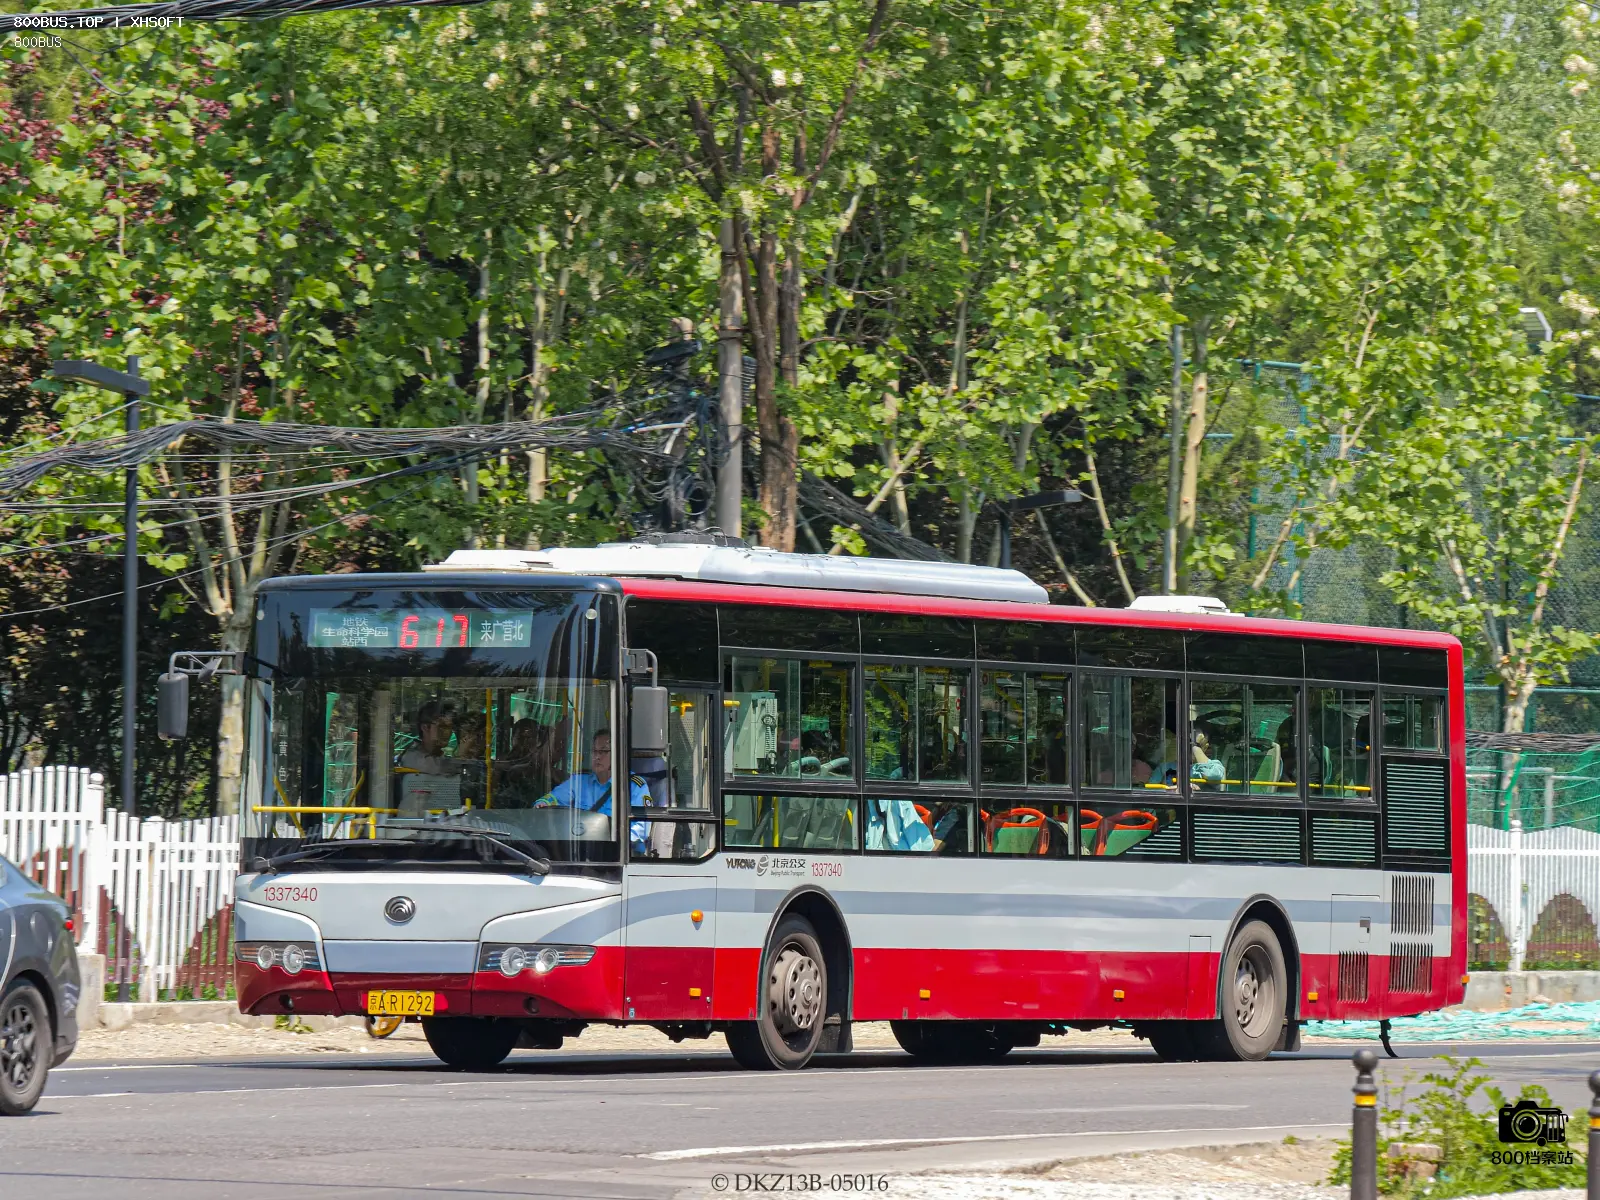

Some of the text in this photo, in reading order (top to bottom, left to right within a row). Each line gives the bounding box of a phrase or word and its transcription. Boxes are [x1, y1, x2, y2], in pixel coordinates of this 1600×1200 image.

[343, 617, 369, 627] 地铁
[322, 626, 389, 637] 生命科学园
[400, 615, 469, 648] 617
[480, 620, 524, 641] 来广营北
[342, 637, 368, 647] 站西
[725, 858, 756, 870] YUTONG
[772, 858, 806, 869] 北京公交
[811, 862, 843, 877] 1337340
[263, 887, 318, 902] 1337340
